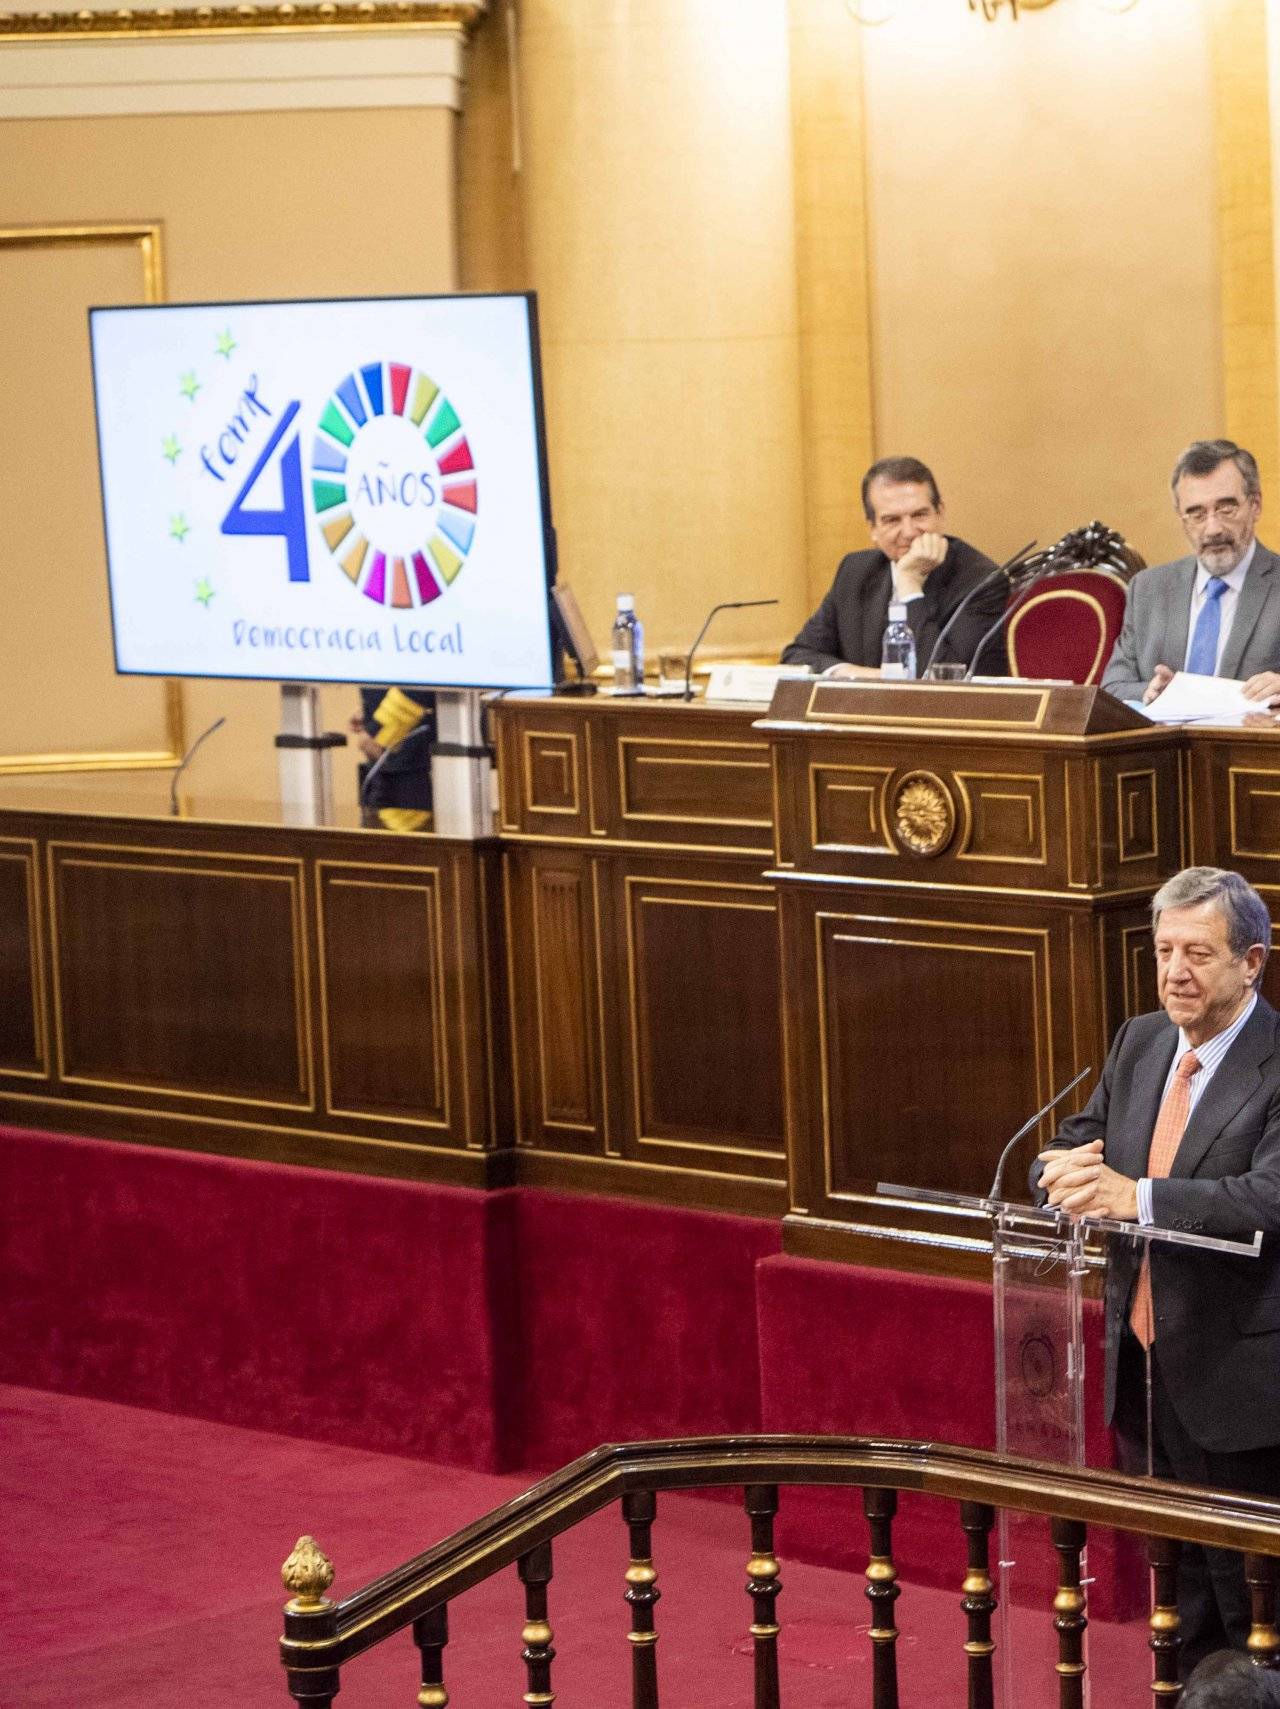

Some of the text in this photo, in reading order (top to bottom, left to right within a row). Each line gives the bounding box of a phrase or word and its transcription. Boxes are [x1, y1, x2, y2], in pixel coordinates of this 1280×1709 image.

[356, 462, 436, 507] AÑOS
[232, 619, 465, 654] Democracia Local
